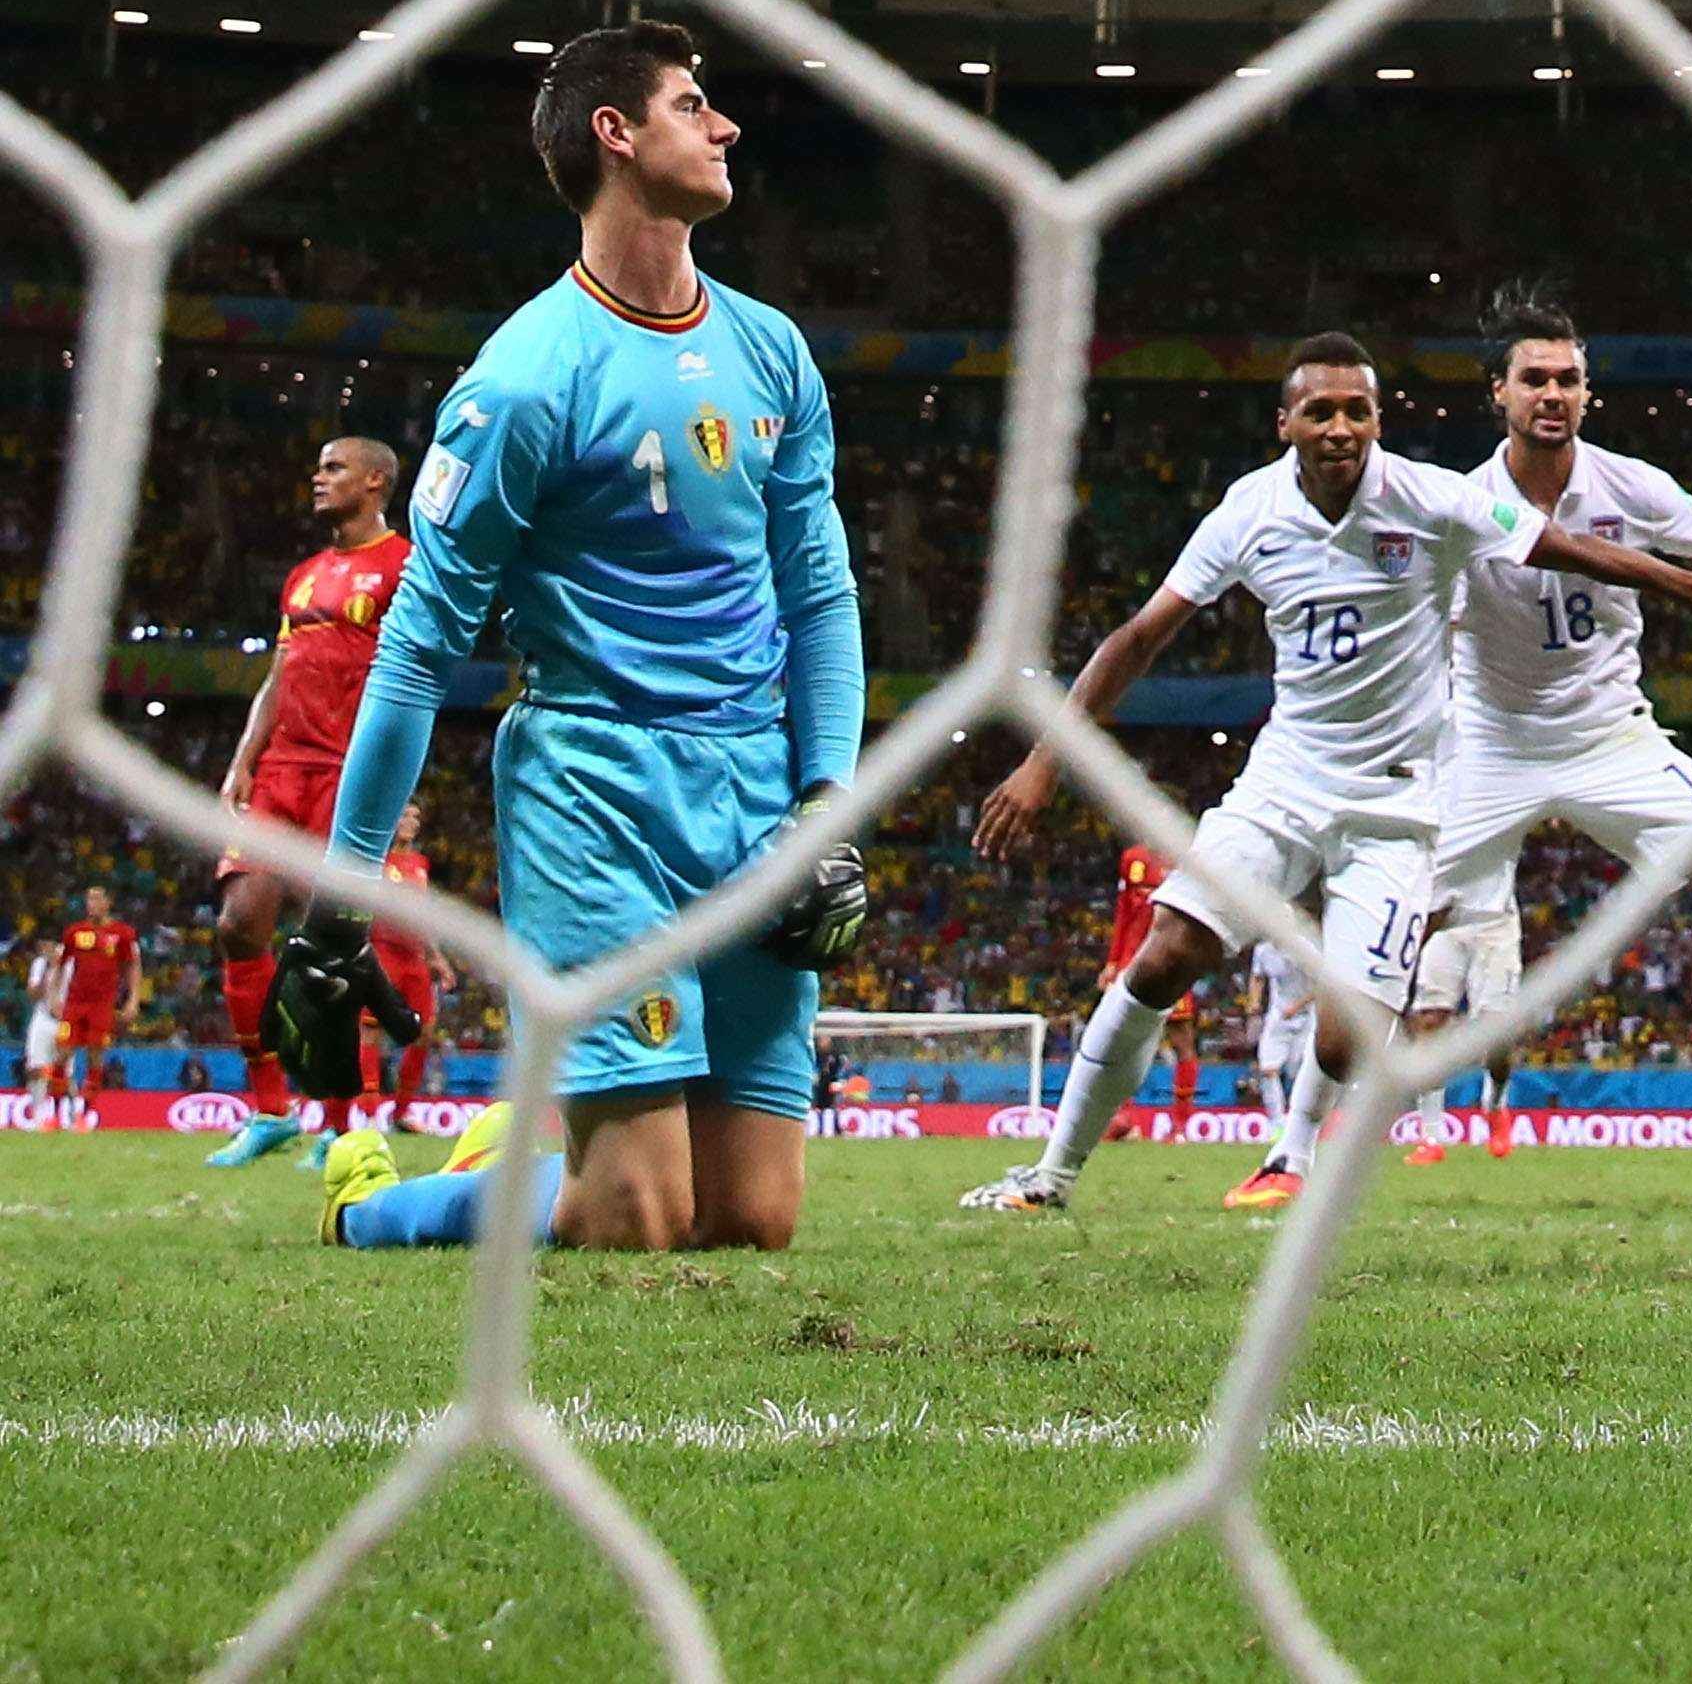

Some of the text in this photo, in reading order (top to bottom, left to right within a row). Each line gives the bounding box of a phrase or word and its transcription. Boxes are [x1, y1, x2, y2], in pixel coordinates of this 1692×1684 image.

[632, 429, 669, 514] 1
[1299, 600, 1363, 663] 16
[1537, 592, 1597, 650] 18
